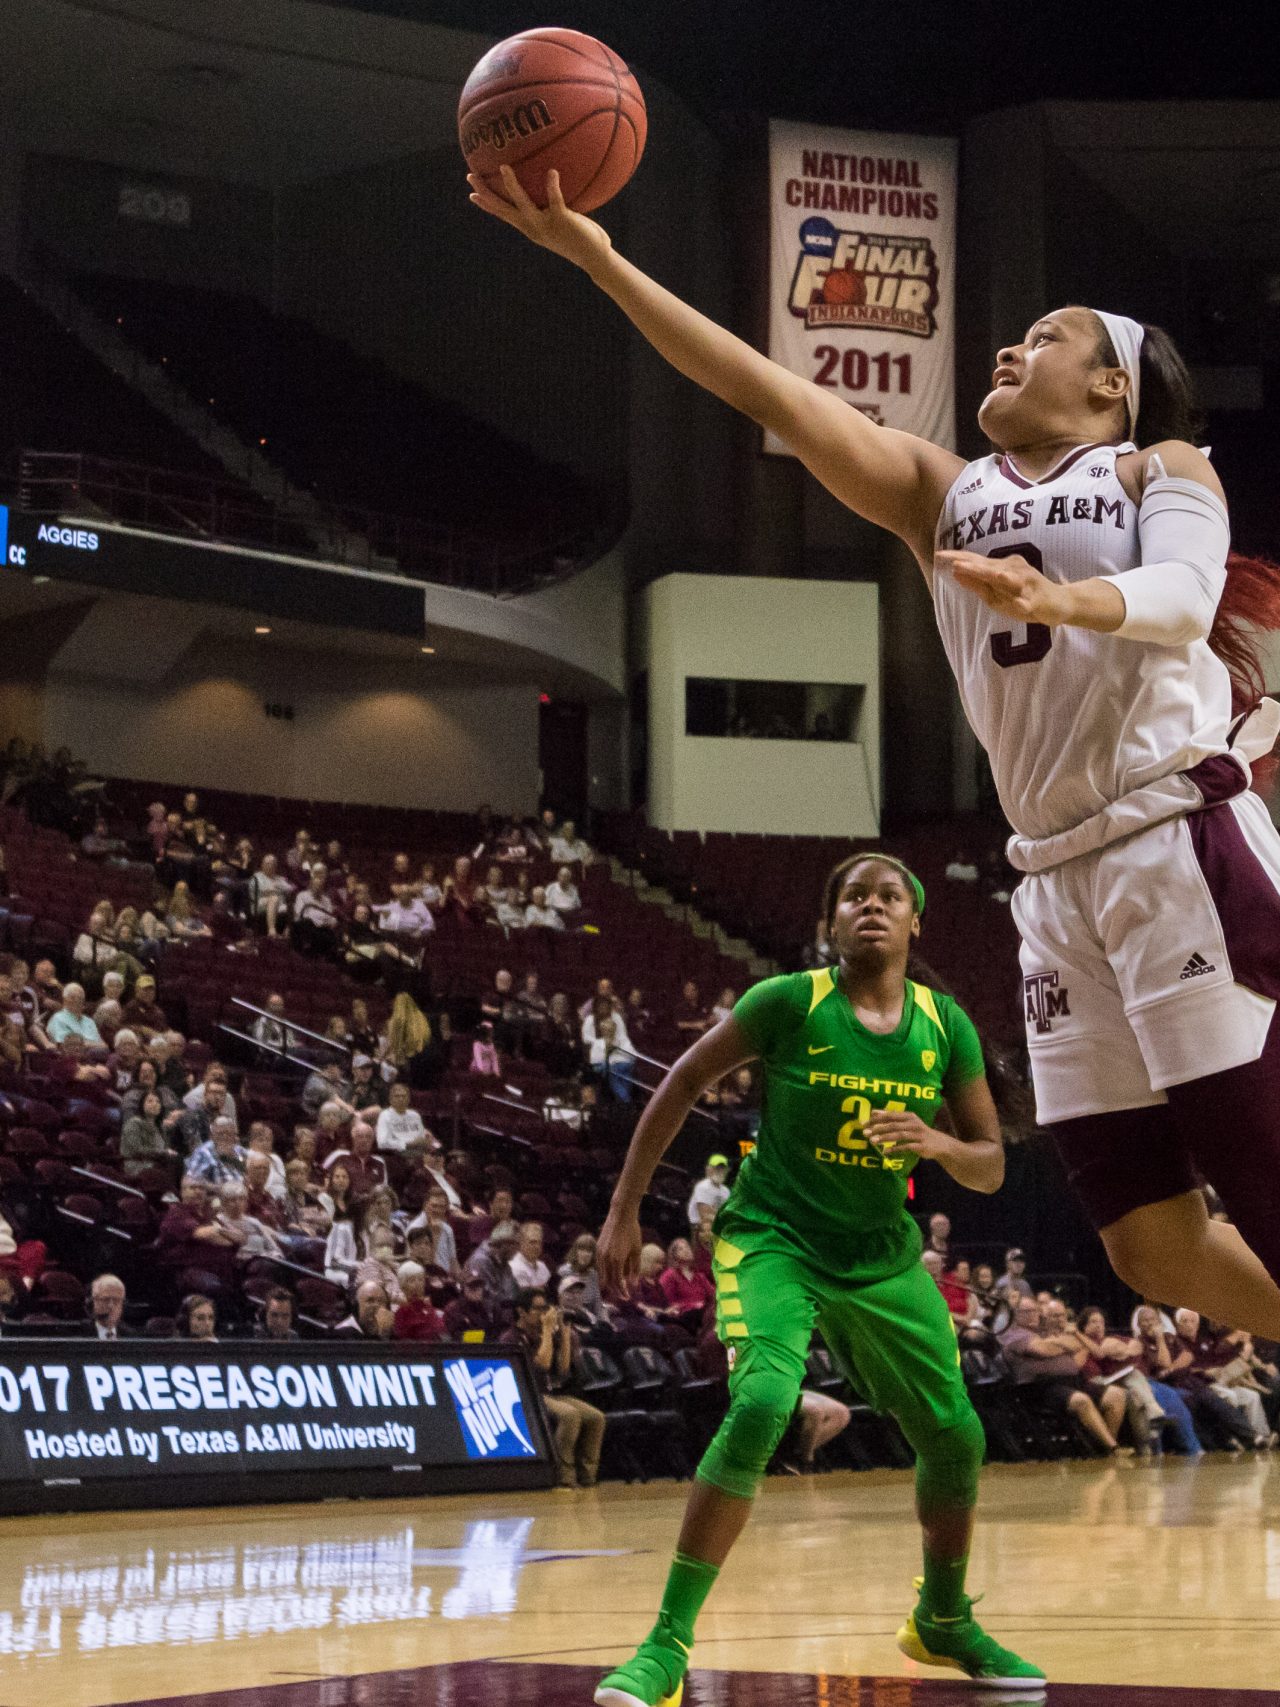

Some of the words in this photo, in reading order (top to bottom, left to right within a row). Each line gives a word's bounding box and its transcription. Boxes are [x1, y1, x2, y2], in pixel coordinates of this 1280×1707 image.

[801, 149, 923, 188] NATIONAL
[785, 178, 939, 220] CHAMPIONS
[832, 234, 930, 276] FINAL
[813, 344, 912, 395] 2011
[1045, 493, 1126, 531] A&M
[37, 522, 99, 551] AGGIES
[1179, 964, 1217, 980] adidas
[808, 1071, 936, 1101] FIGHTING
[83, 1363, 337, 1412] PRESEASON
[338, 1364, 438, 1407] WNIT
[25, 1426, 119, 1462] Hosted
[129, 1428, 158, 1465] by
[161, 1424, 240, 1457] Texas
[245, 1422, 302, 1454] A&M
[303, 1420, 416, 1457] University
